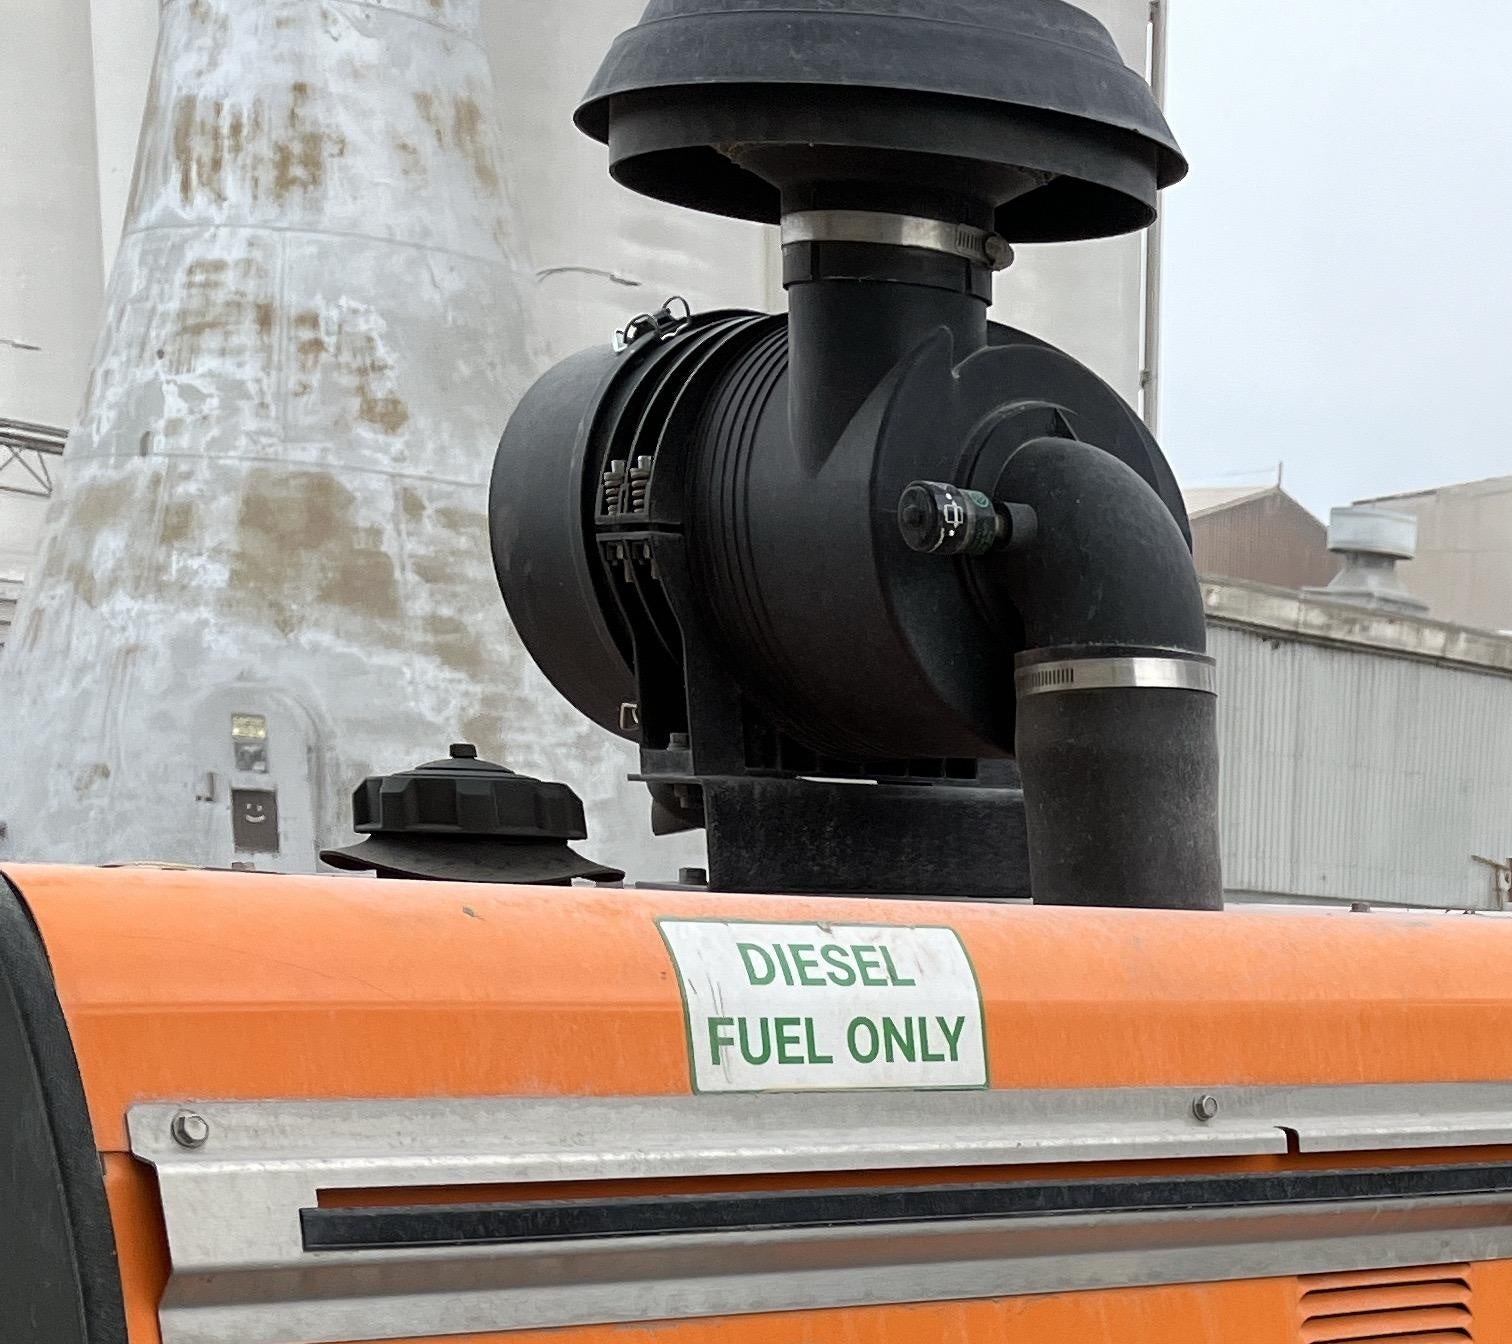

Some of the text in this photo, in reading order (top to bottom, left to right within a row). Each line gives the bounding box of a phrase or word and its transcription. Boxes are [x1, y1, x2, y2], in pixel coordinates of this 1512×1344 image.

[736, 942, 916, 987] DIESEL
[707, 1015, 966, 1065] FUEL ONLY
